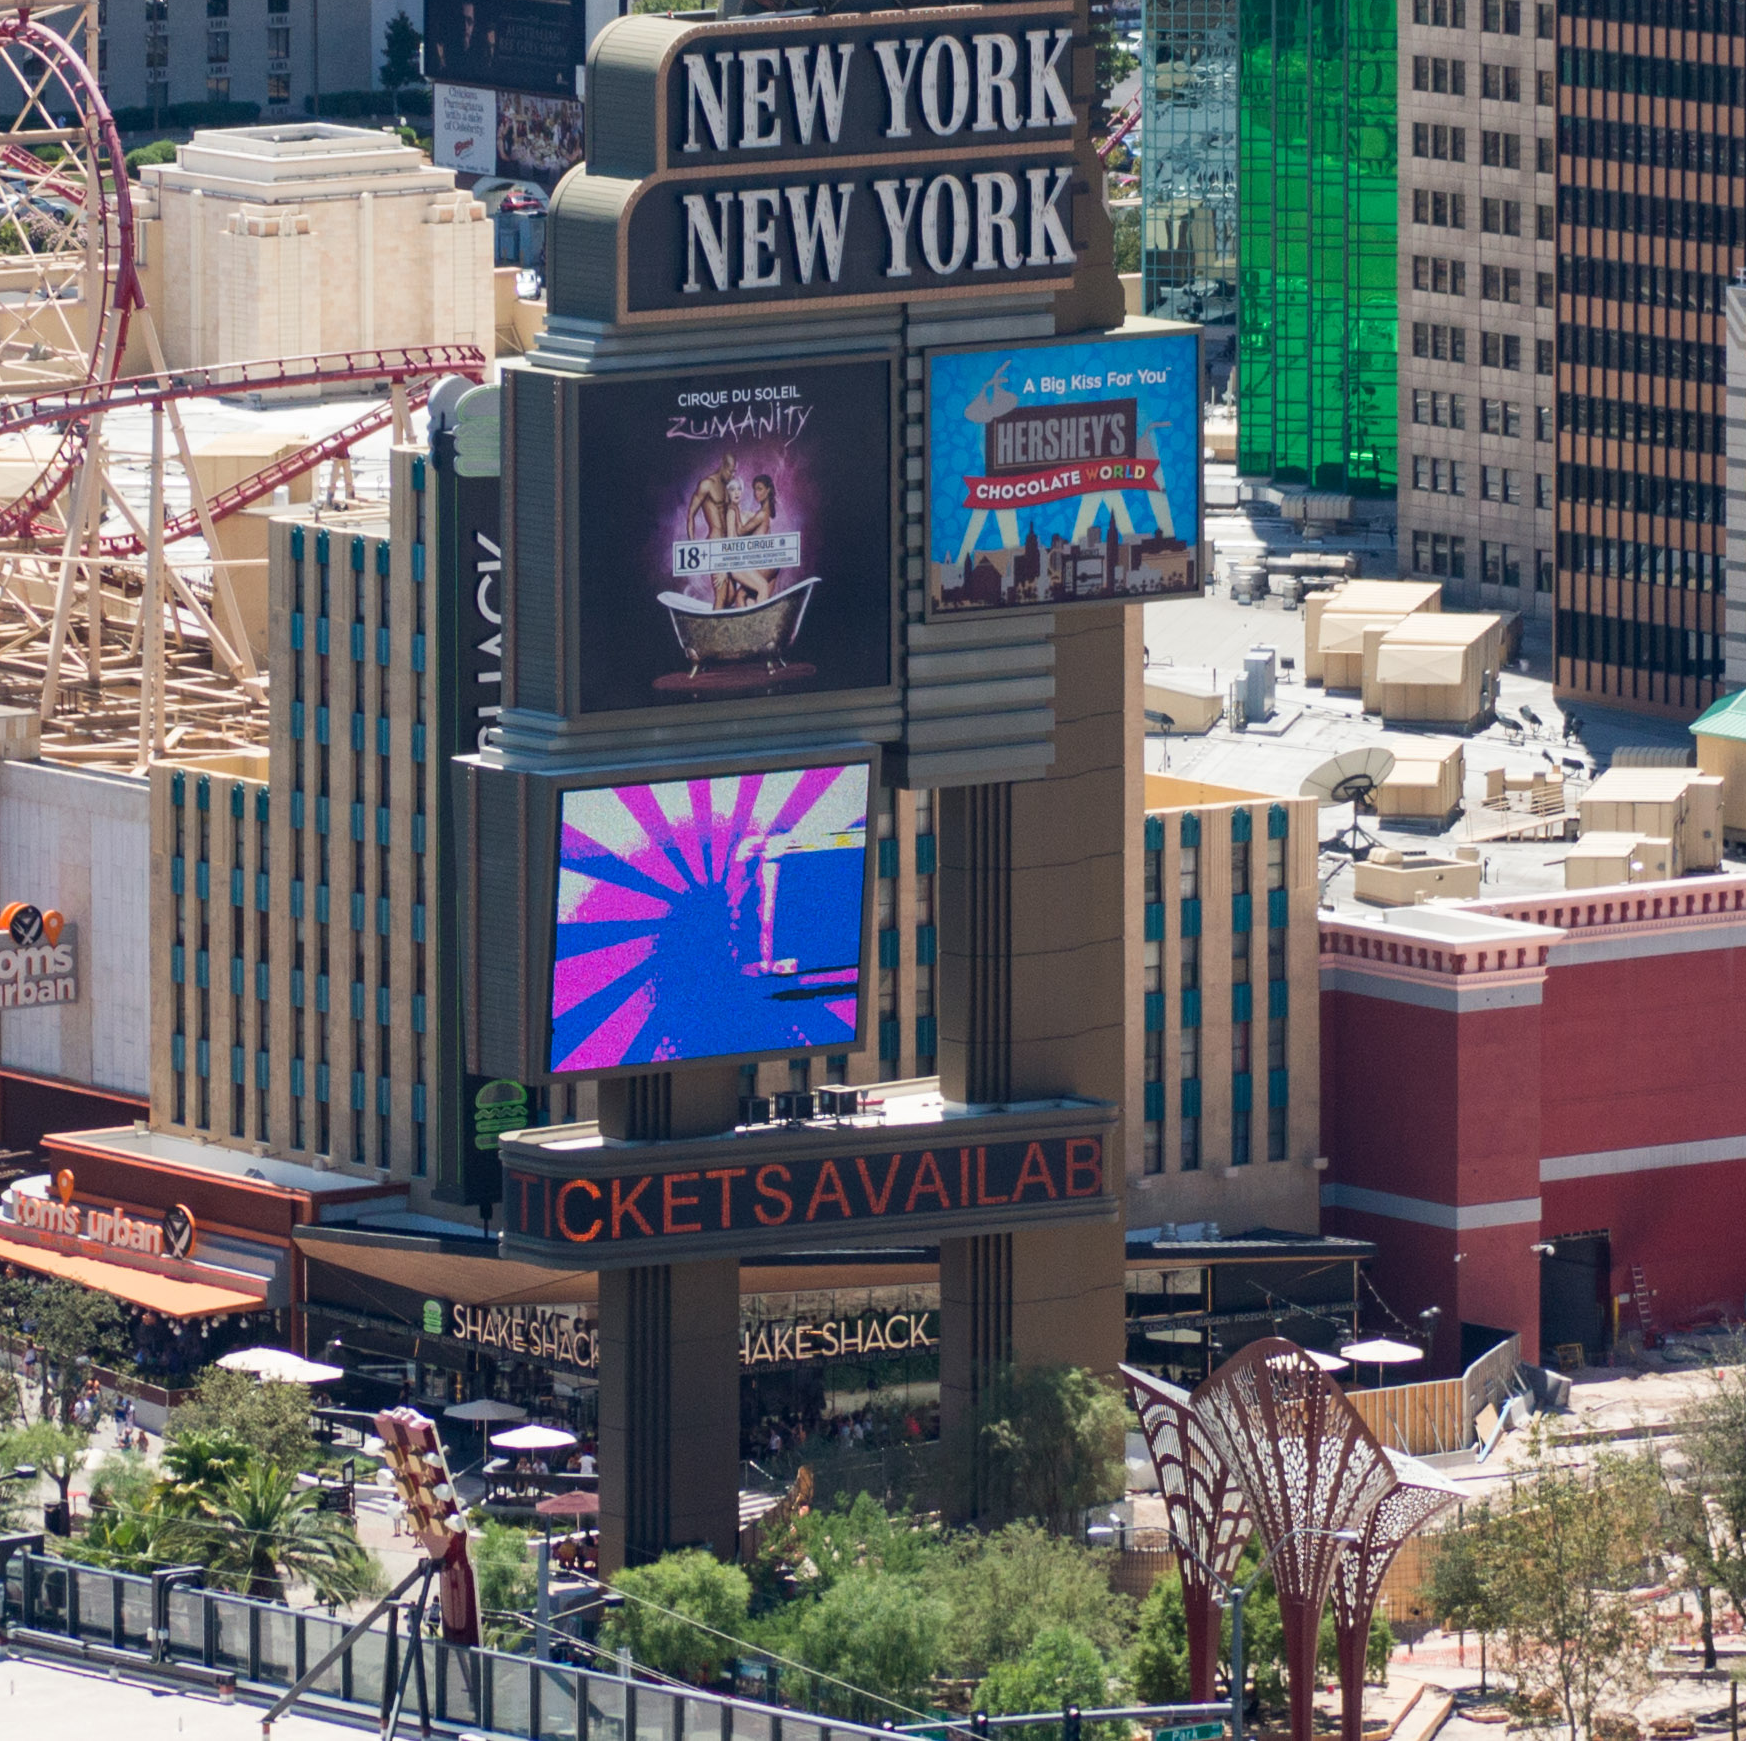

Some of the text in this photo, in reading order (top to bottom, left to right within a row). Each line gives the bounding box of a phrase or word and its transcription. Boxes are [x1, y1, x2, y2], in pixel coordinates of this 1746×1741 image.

[682, 28, 1077, 153] NEW YORK
[682, 167, 1077, 294] NEW YORK
[678, 385, 801, 408] CIRQUE DU SOLEIL
[1023, 378, 1035, 394] A
[1041, 376, 1066, 394] Big
[1071, 373, 1102, 390] Kiss
[1107, 371, 1132, 387] For
[997, 413, 1126, 465] HERSHEY'S
[976, 465, 1146, 500] CHOCOLATE WORLD
[678, 546, 708, 570] 18+
[721, 541, 746, 552] RATED
[747, 538, 775, 550] CIRQUE
[12, 1190, 164, 1255] toms urban
[453, 1304, 525, 1352] SHAKE
[821, 1313, 931, 1356] SHACK
[1171, 1728, 1198, 1741] Park
